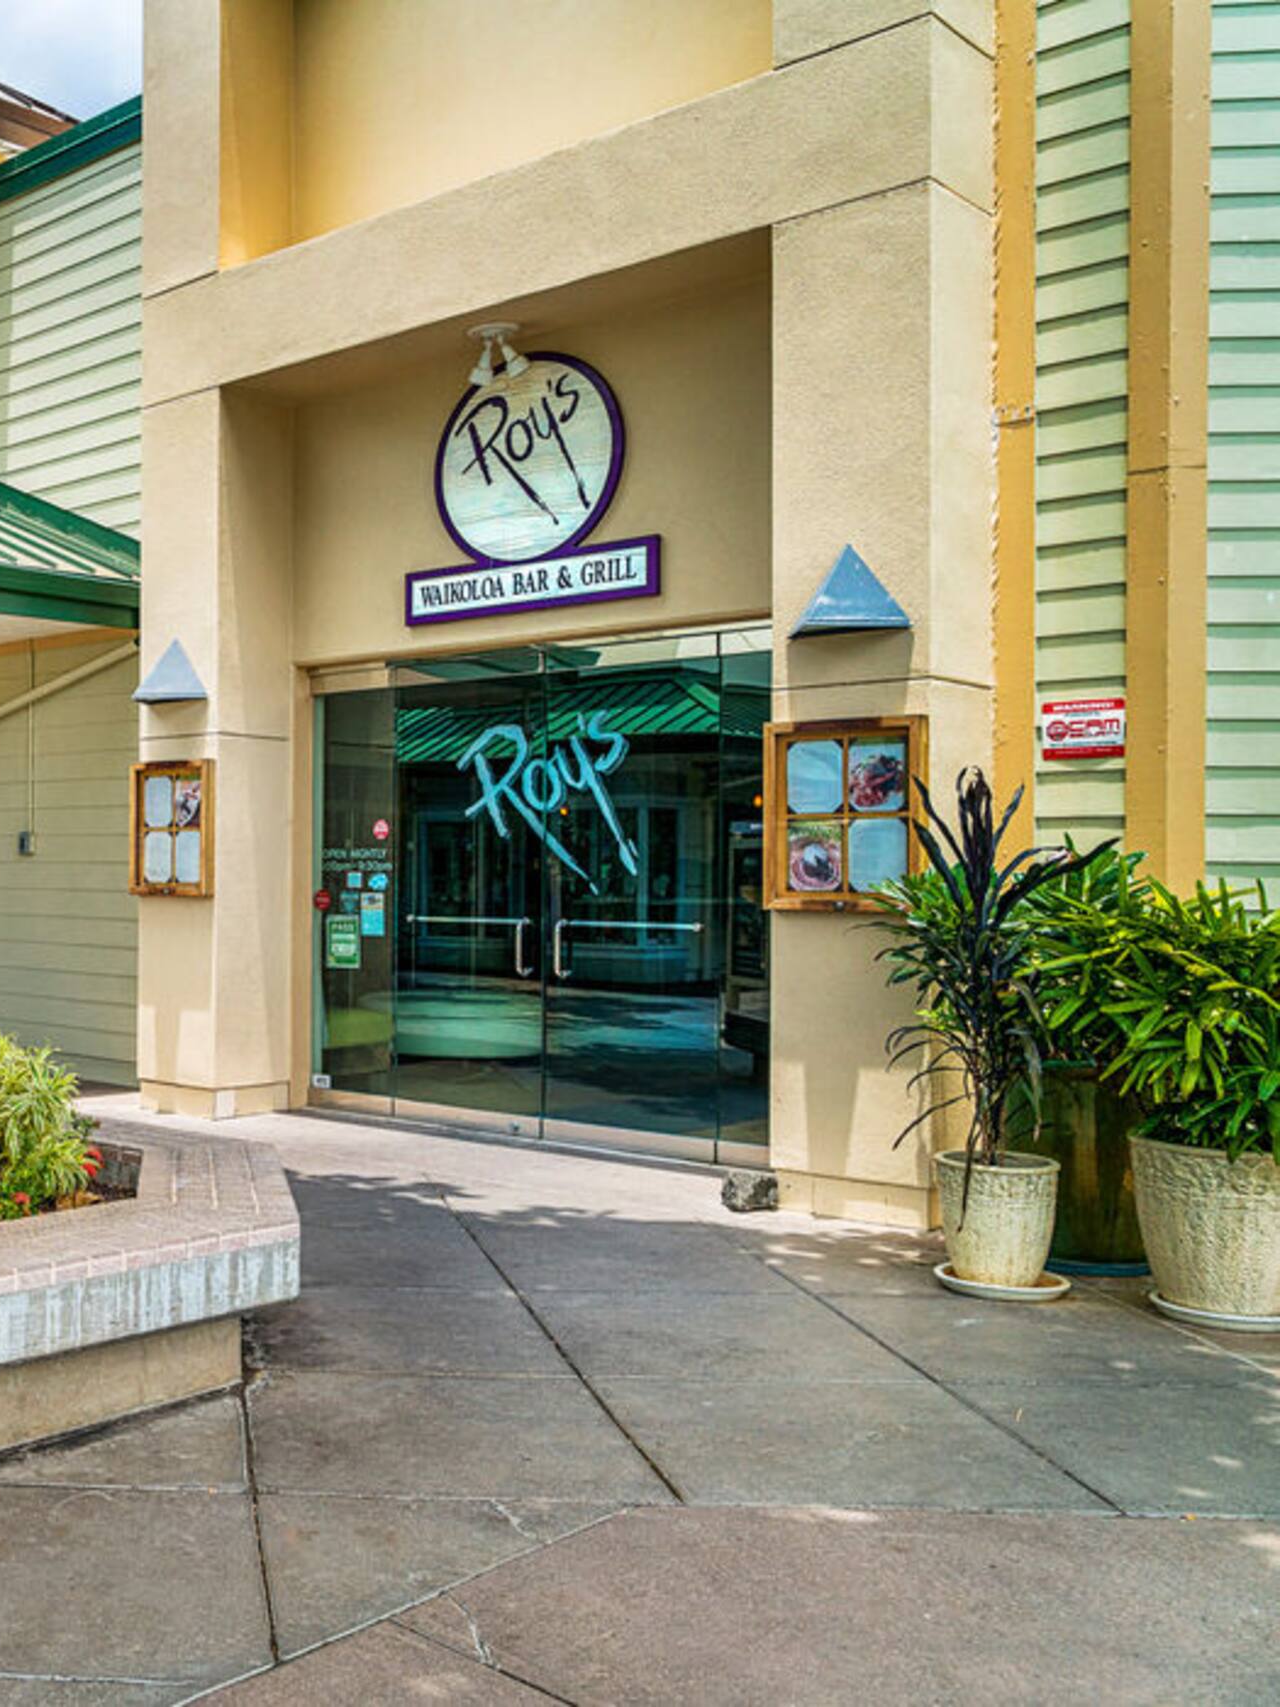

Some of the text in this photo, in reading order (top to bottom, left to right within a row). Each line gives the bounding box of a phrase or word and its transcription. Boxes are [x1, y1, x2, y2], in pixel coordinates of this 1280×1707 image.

[455, 373, 590, 525] Roy's
[419, 555, 638, 607] WAIKOLOA BAR & GRILL
[456, 709, 640, 896] Roy's
